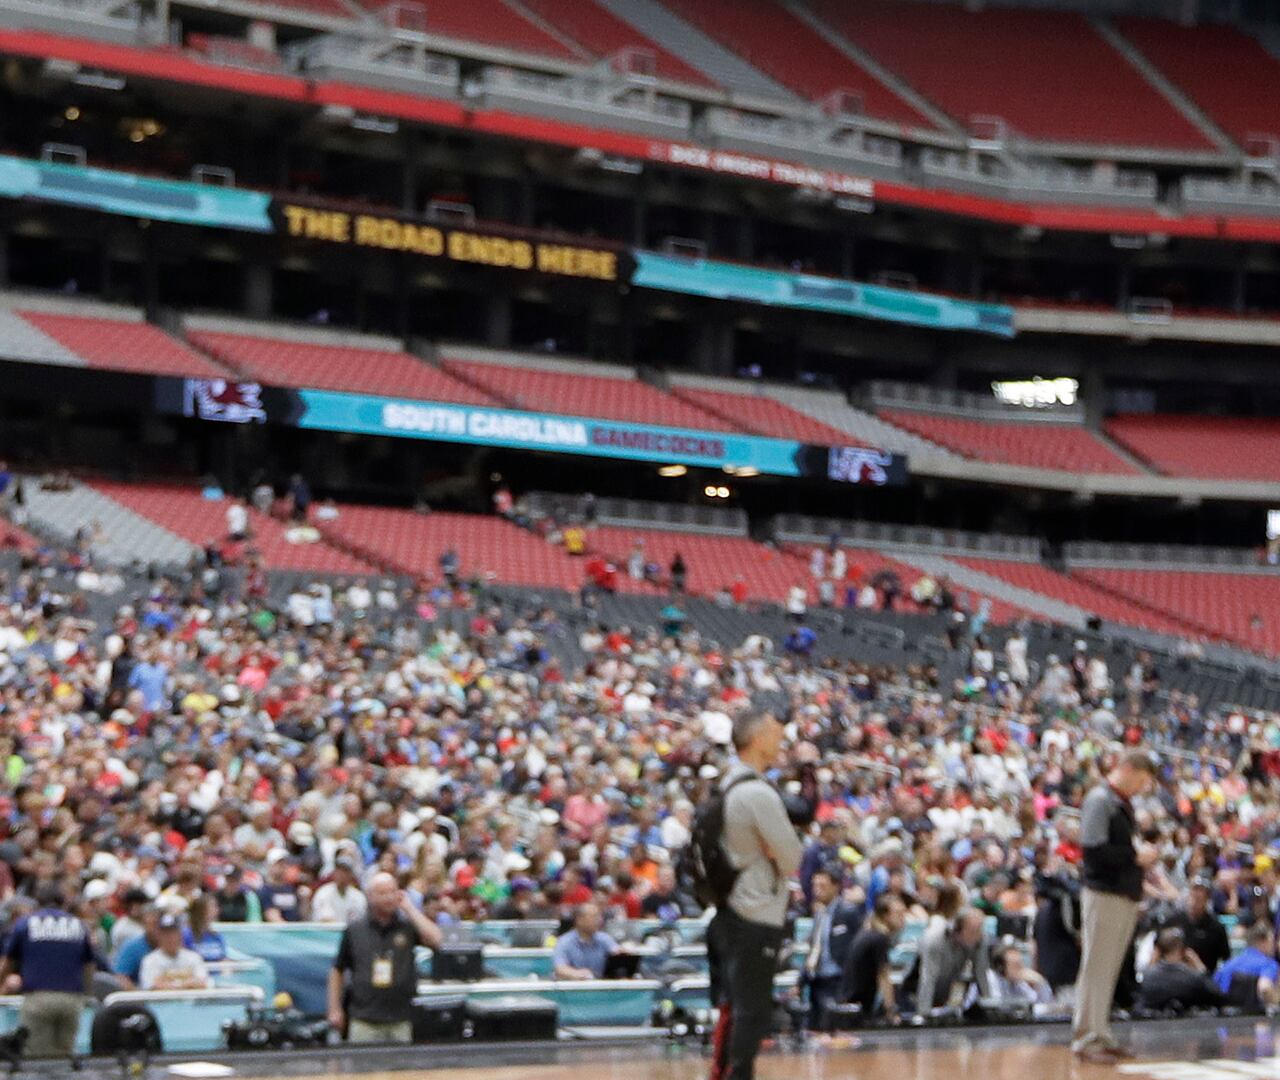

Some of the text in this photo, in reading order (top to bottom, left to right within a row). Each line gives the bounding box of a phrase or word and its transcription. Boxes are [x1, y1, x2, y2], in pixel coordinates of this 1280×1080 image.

[283, 204, 617, 281] THE ROAD ENDS HERE
[382, 402, 726, 458] SOUTH CAROLINA GAMECOCKS
